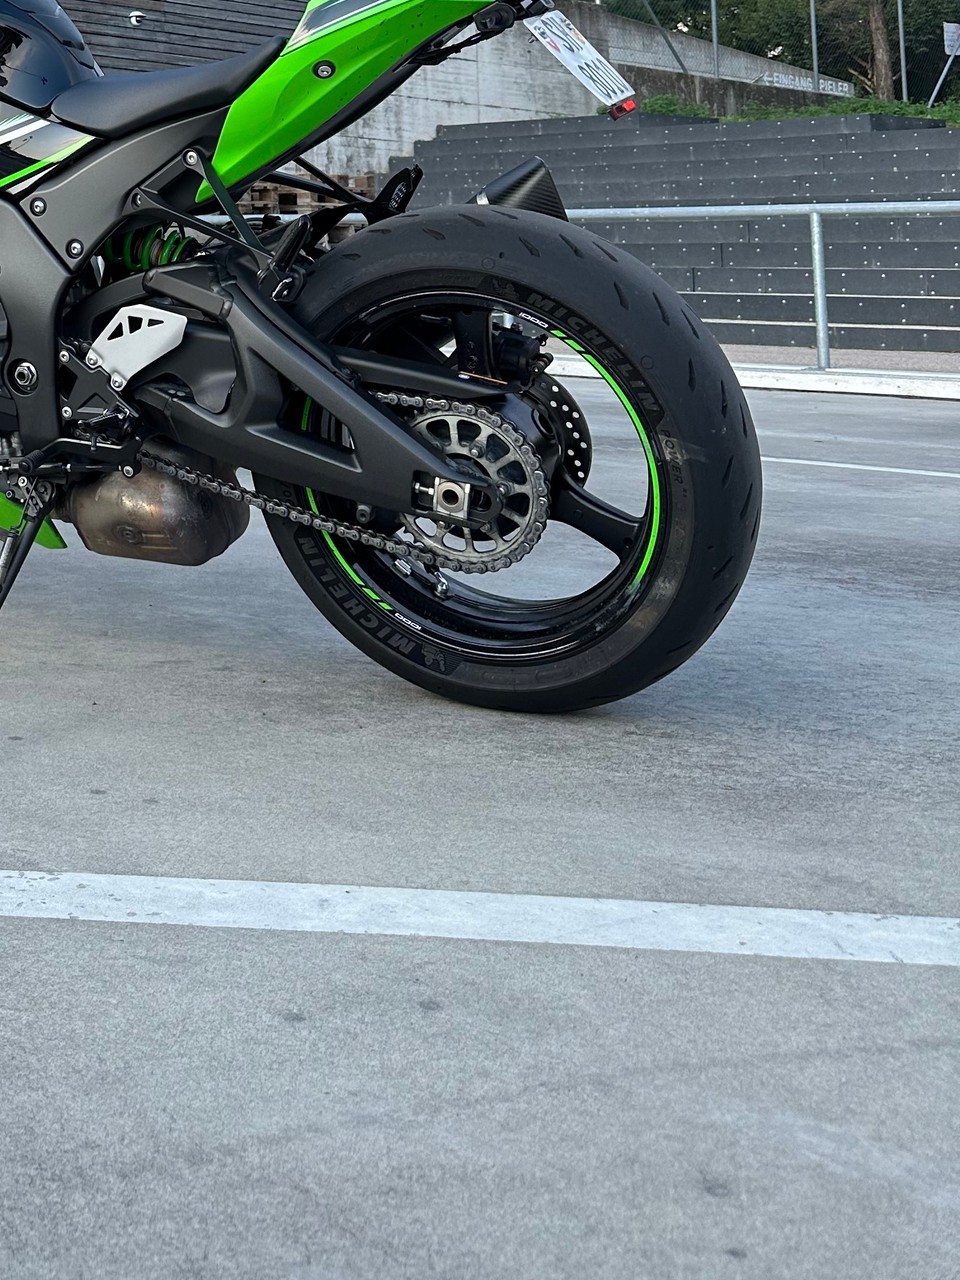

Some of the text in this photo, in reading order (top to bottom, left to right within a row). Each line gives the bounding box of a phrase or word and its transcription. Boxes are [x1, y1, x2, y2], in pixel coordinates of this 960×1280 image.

[541, 17, 583, 53] SH
[578, 58, 629, 98] 8010
[773, 73, 849, 94] EINGANG PIELER
[519, 312, 548, 329] 1000
[525, 291, 659, 415] MICHELIN
[297, 537, 417, 656] MICHELIN
[394, 612, 422, 630] 1000
